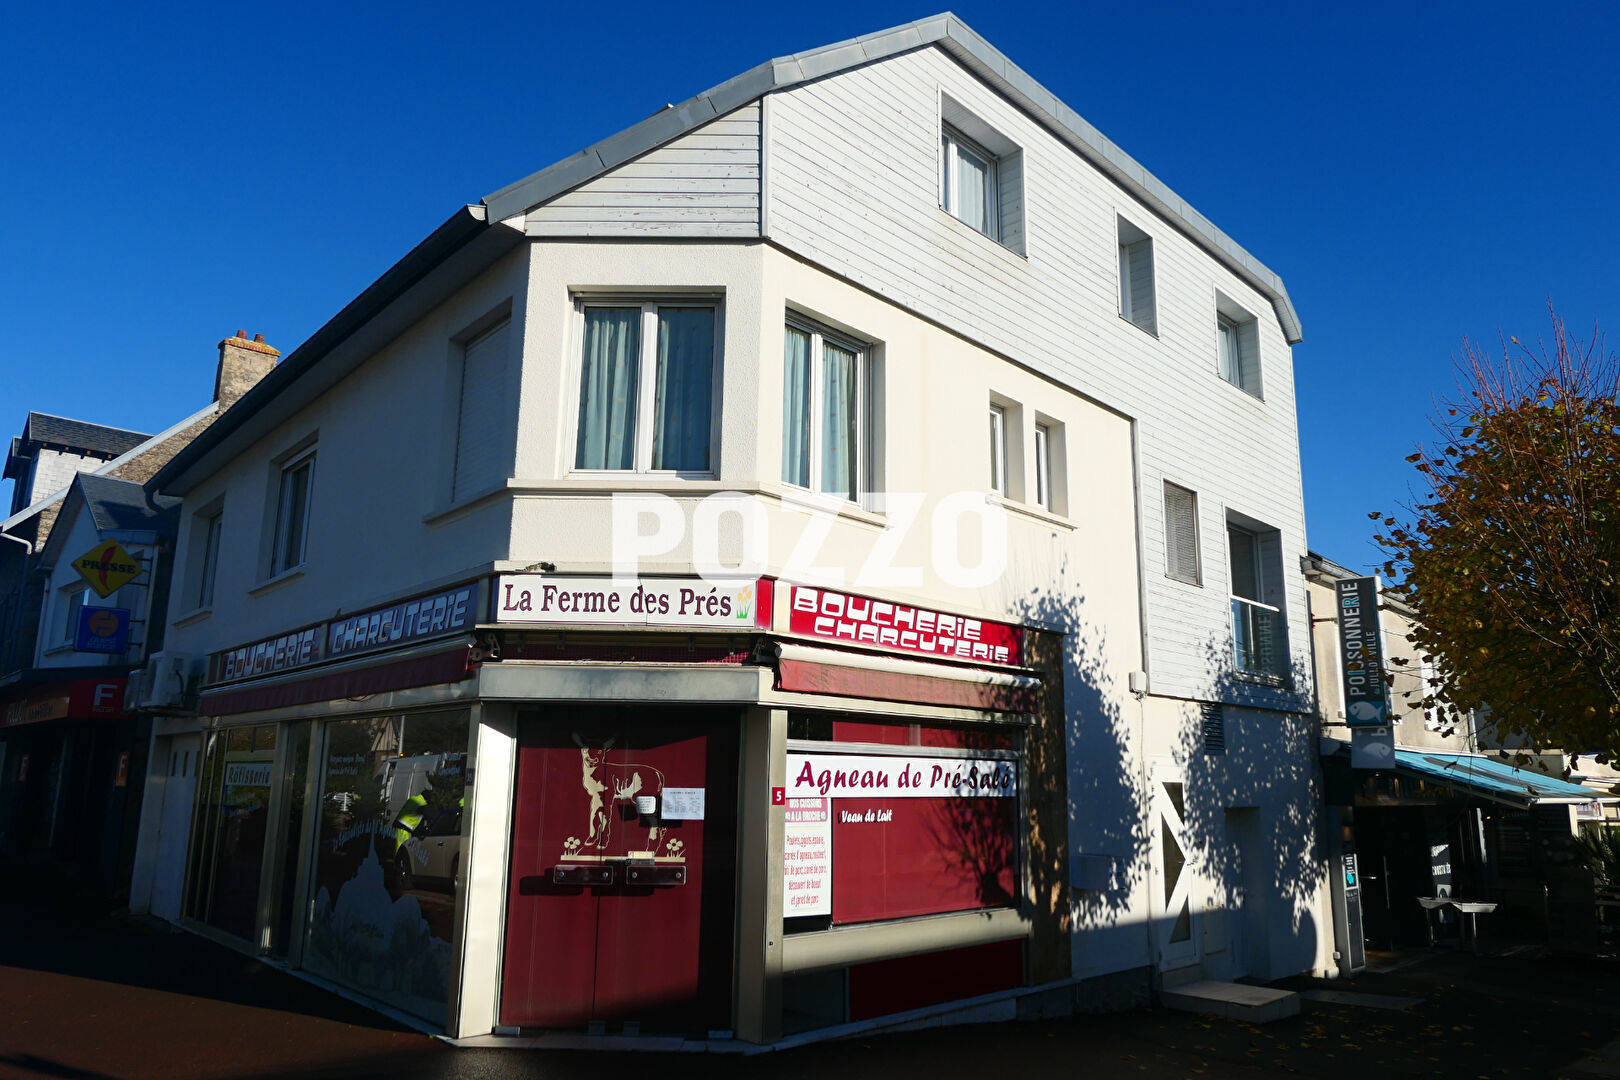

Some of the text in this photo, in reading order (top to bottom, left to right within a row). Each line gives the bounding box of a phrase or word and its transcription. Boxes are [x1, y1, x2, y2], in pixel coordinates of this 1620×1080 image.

[82, 559, 136, 574] PRESSE
[503, 584, 732, 616] La Ferme des Prés
[793, 586, 982, 640] BOUCHERIE
[332, 590, 470, 653] CHARCUTERIE
[224, 629, 315, 680] BOUCHERIE
[814, 616, 1009, 662] CHARCUTERIE
[1366, 631, 1380, 688] JULLOVILLE
[93, 683, 118, 706] F
[795, 761, 1010, 795] Agneau de Pré-Salé
[776, 791, 782, 801] 5
[789, 798, 799, 808] NOS
[795, 811, 802, 821] LA
[841, 809, 893, 823] Veau de Lait
